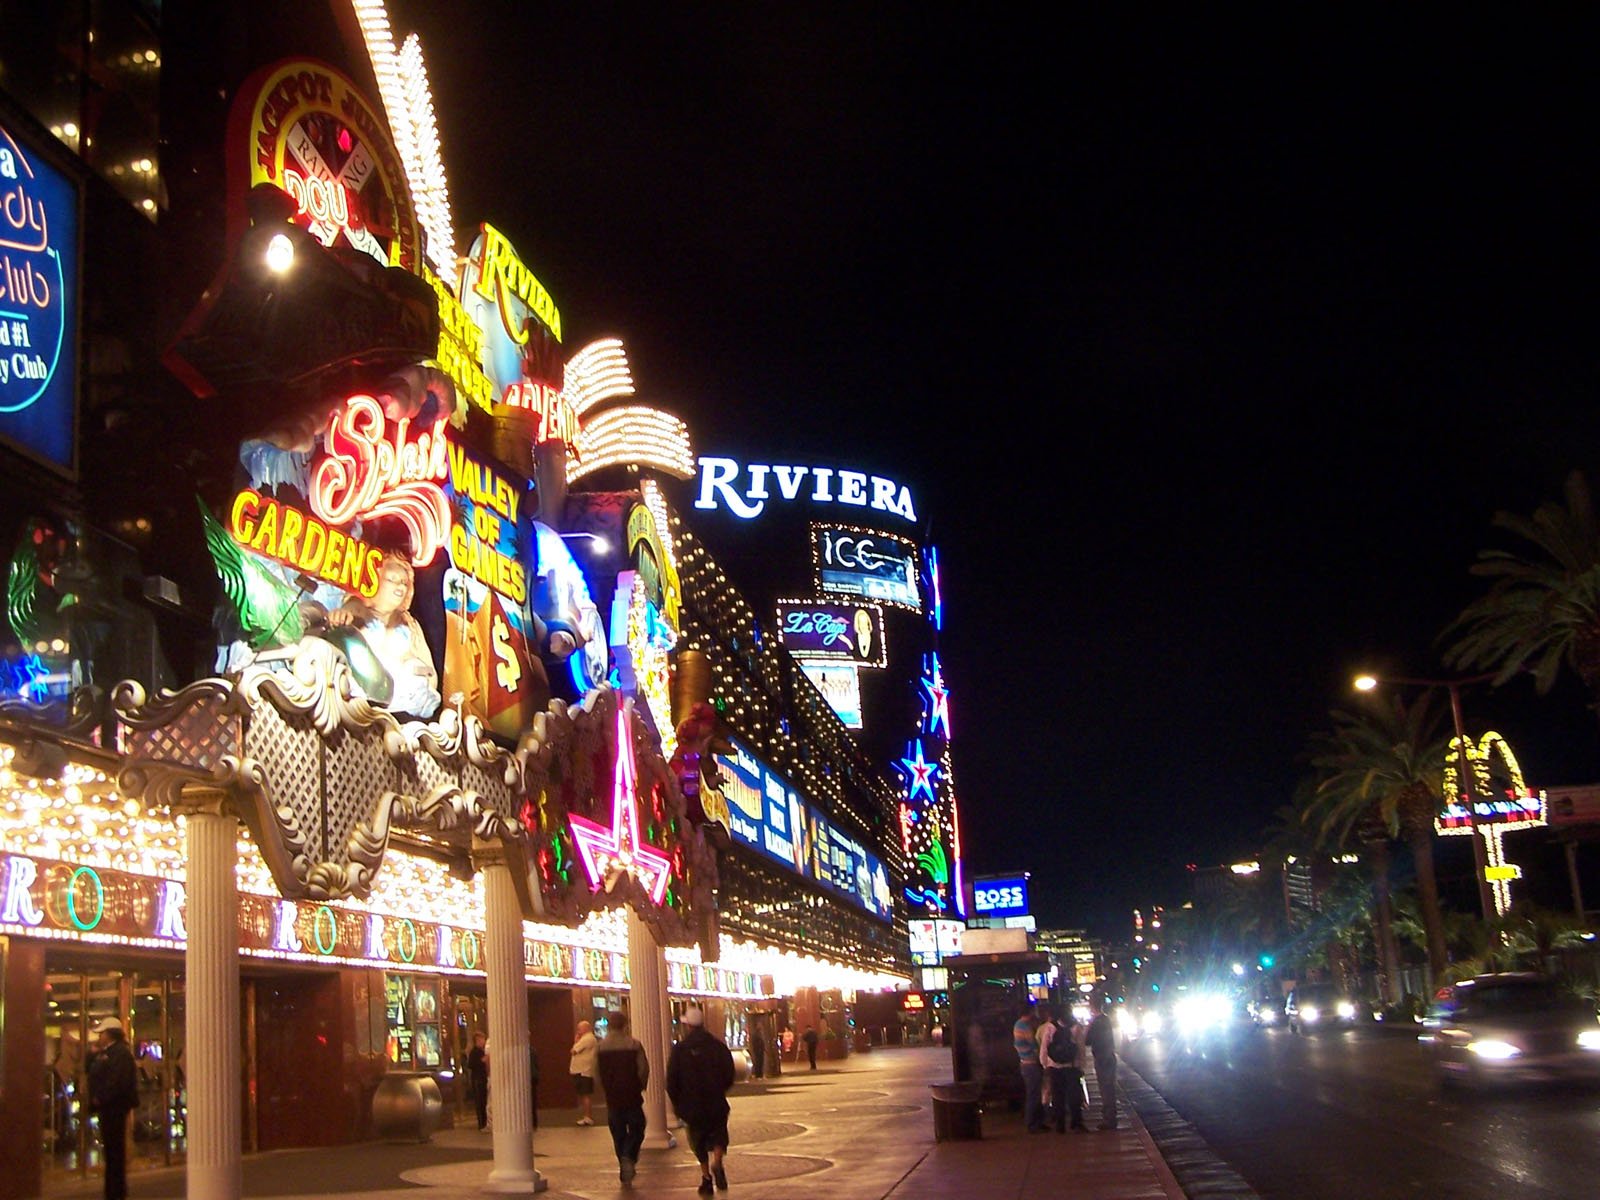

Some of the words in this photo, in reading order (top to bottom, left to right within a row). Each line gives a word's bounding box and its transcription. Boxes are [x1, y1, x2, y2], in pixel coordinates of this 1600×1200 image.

[256, 70, 334, 181] JACKPOT
[474, 221, 563, 345] RIVIERA
[11, 354, 48, 380] Club
[309, 394, 450, 526] Splash
[447, 440, 520, 524] VALLEY
[693, 456, 918, 523] RIVIERA
[230, 490, 385, 599] GARDENS
[450, 523, 527, 605] GAMES
[473, 505, 501, 546] OF
[974, 886, 1024, 907] ROSS
